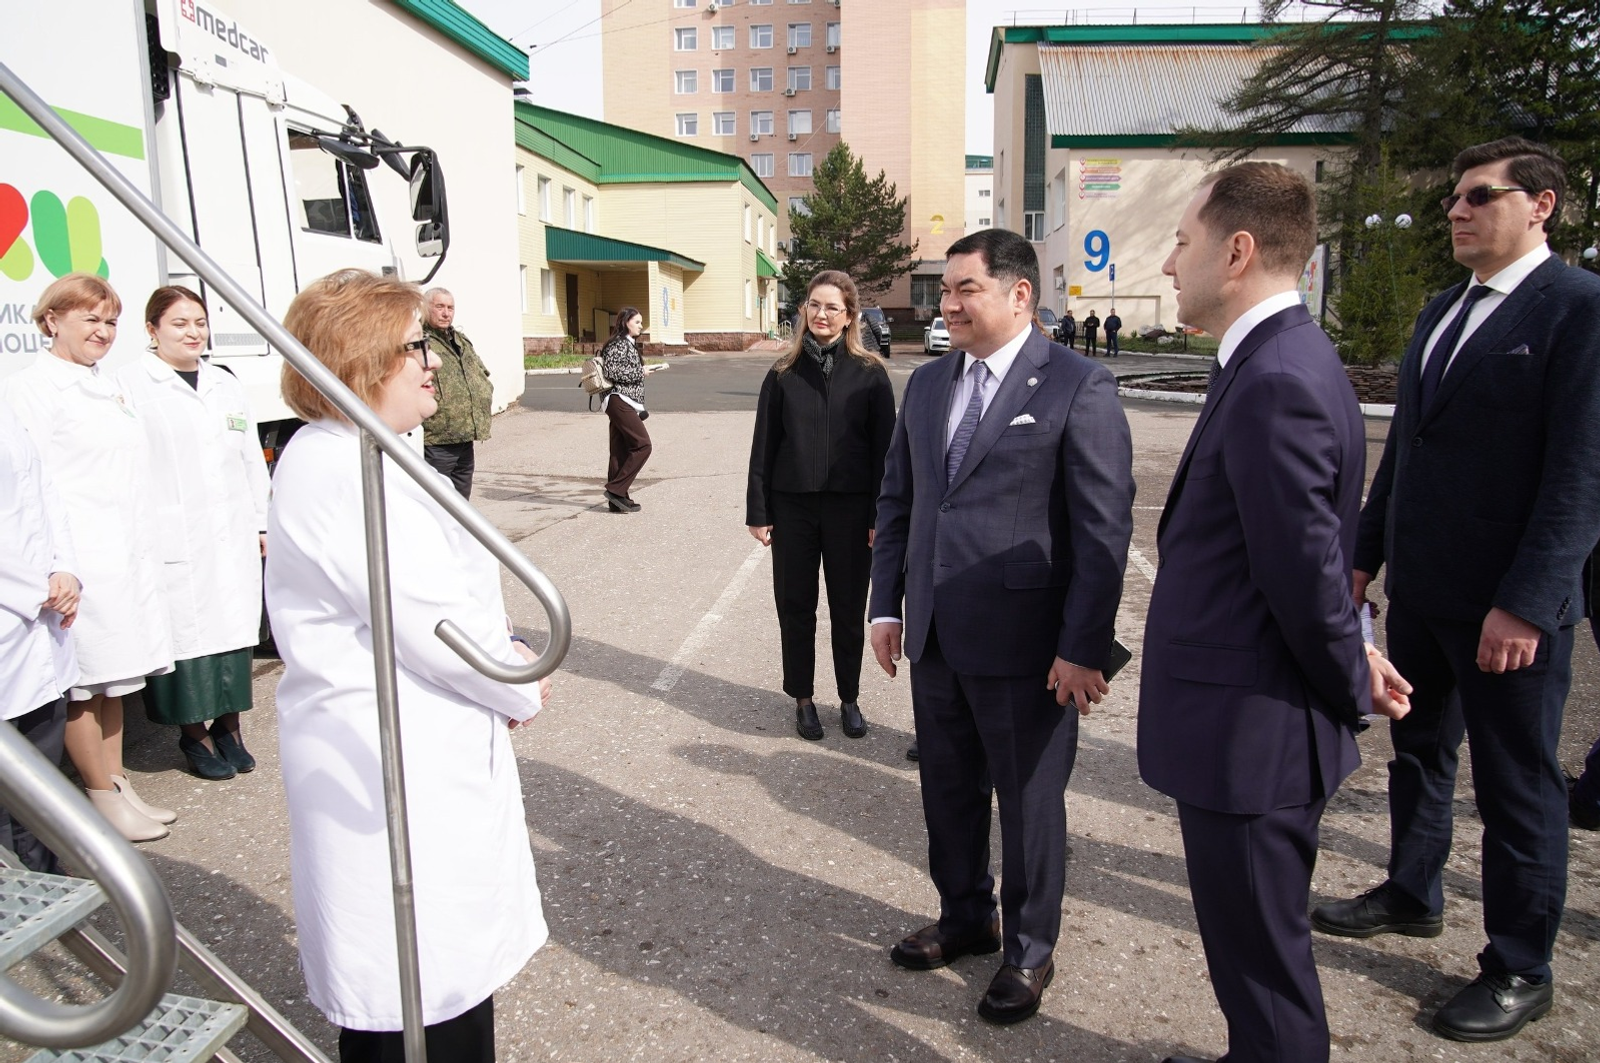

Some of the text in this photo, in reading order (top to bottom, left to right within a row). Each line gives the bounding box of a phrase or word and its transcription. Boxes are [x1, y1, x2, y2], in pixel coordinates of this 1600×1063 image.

[196, 6, 269, 64] medcar
[931, 214, 944, 234] 2
[1084, 230, 1110, 272] 9
[663, 287, 669, 327] 8
